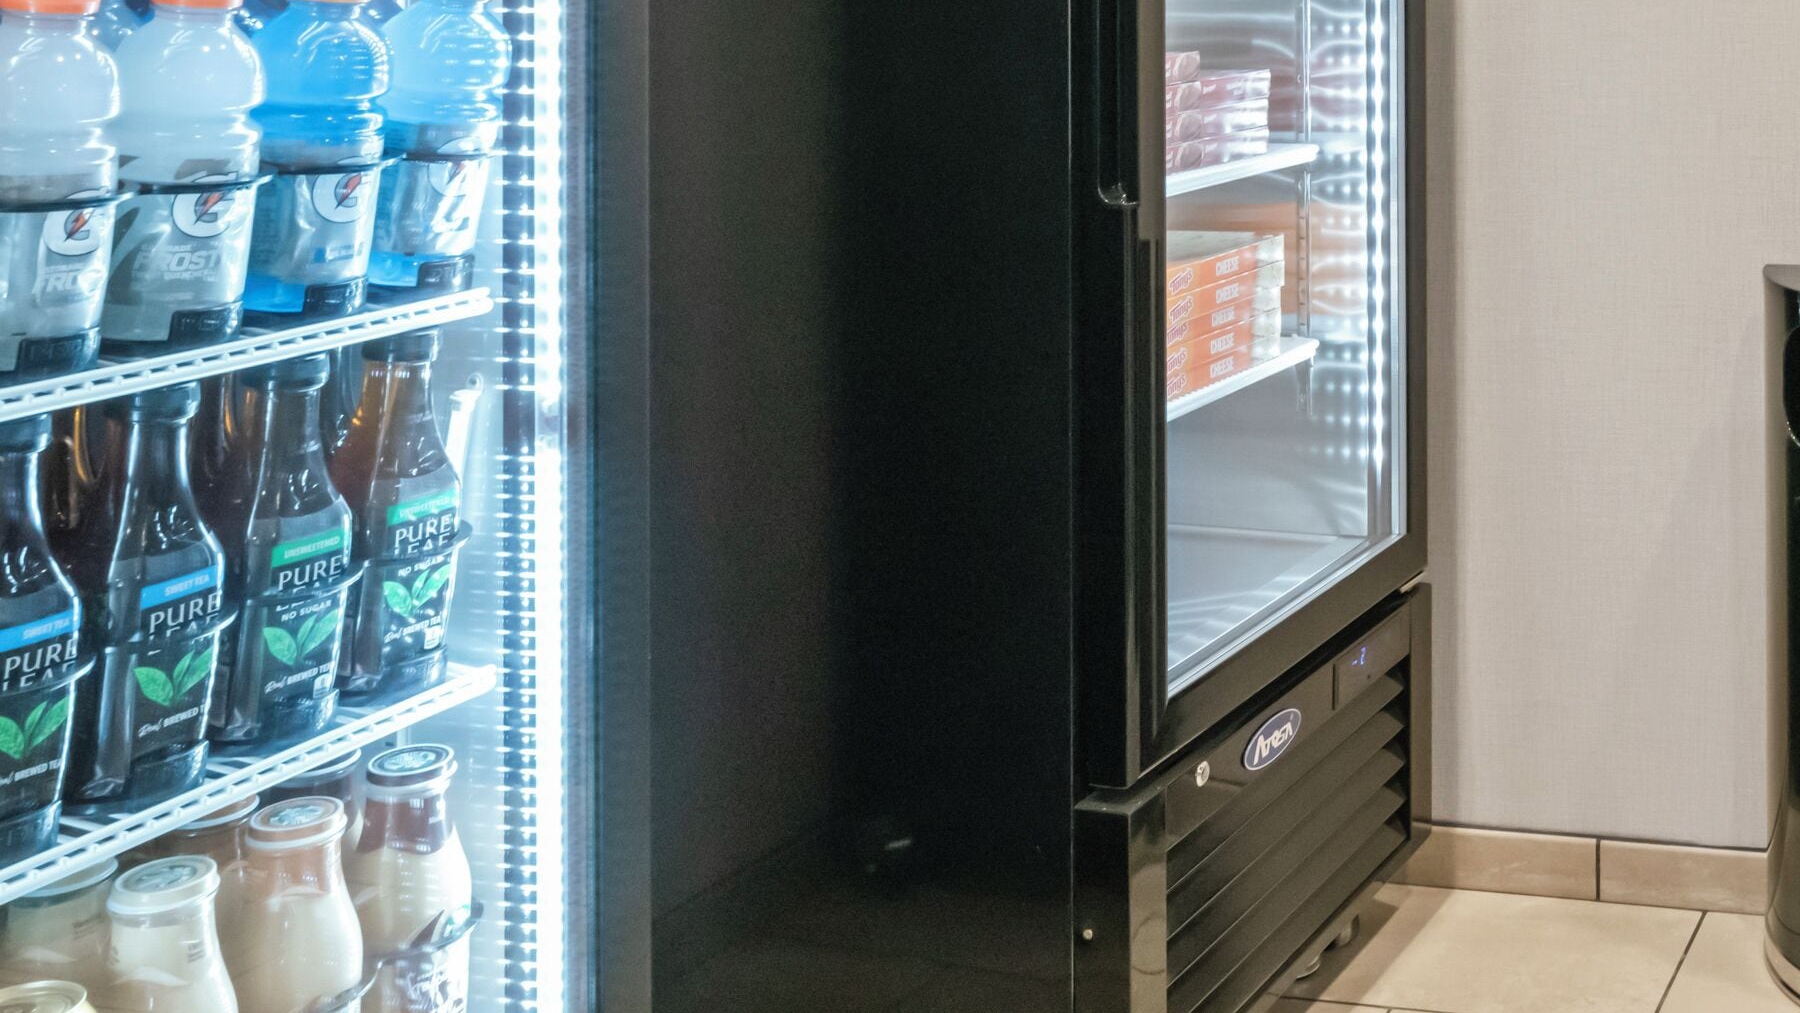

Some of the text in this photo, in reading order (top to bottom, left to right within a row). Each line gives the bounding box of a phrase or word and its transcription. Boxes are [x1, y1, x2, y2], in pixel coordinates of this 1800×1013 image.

[1216, 256, 1240, 277] CHEESE
[1216, 283, 1240, 304] CHEESE
[1212, 307, 1235, 327] CHEESE
[1167, 333, 1234, 373] ony's CHEESE
[1167, 357, 1234, 398] ony's CHEESE
[394, 513, 454, 548] PURE
[284, 535, 341, 559] UNSWEETENED
[278, 554, 343, 592] PURE
[149, 592, 220, 634] PURE
[281, 599, 332, 622] NO SUGAR
[4, 638, 78, 679] PURE
[287, 666, 319, 686] BREWED
[163, 706, 199, 728] BREWED
[15, 761, 48, 782] BREWED
